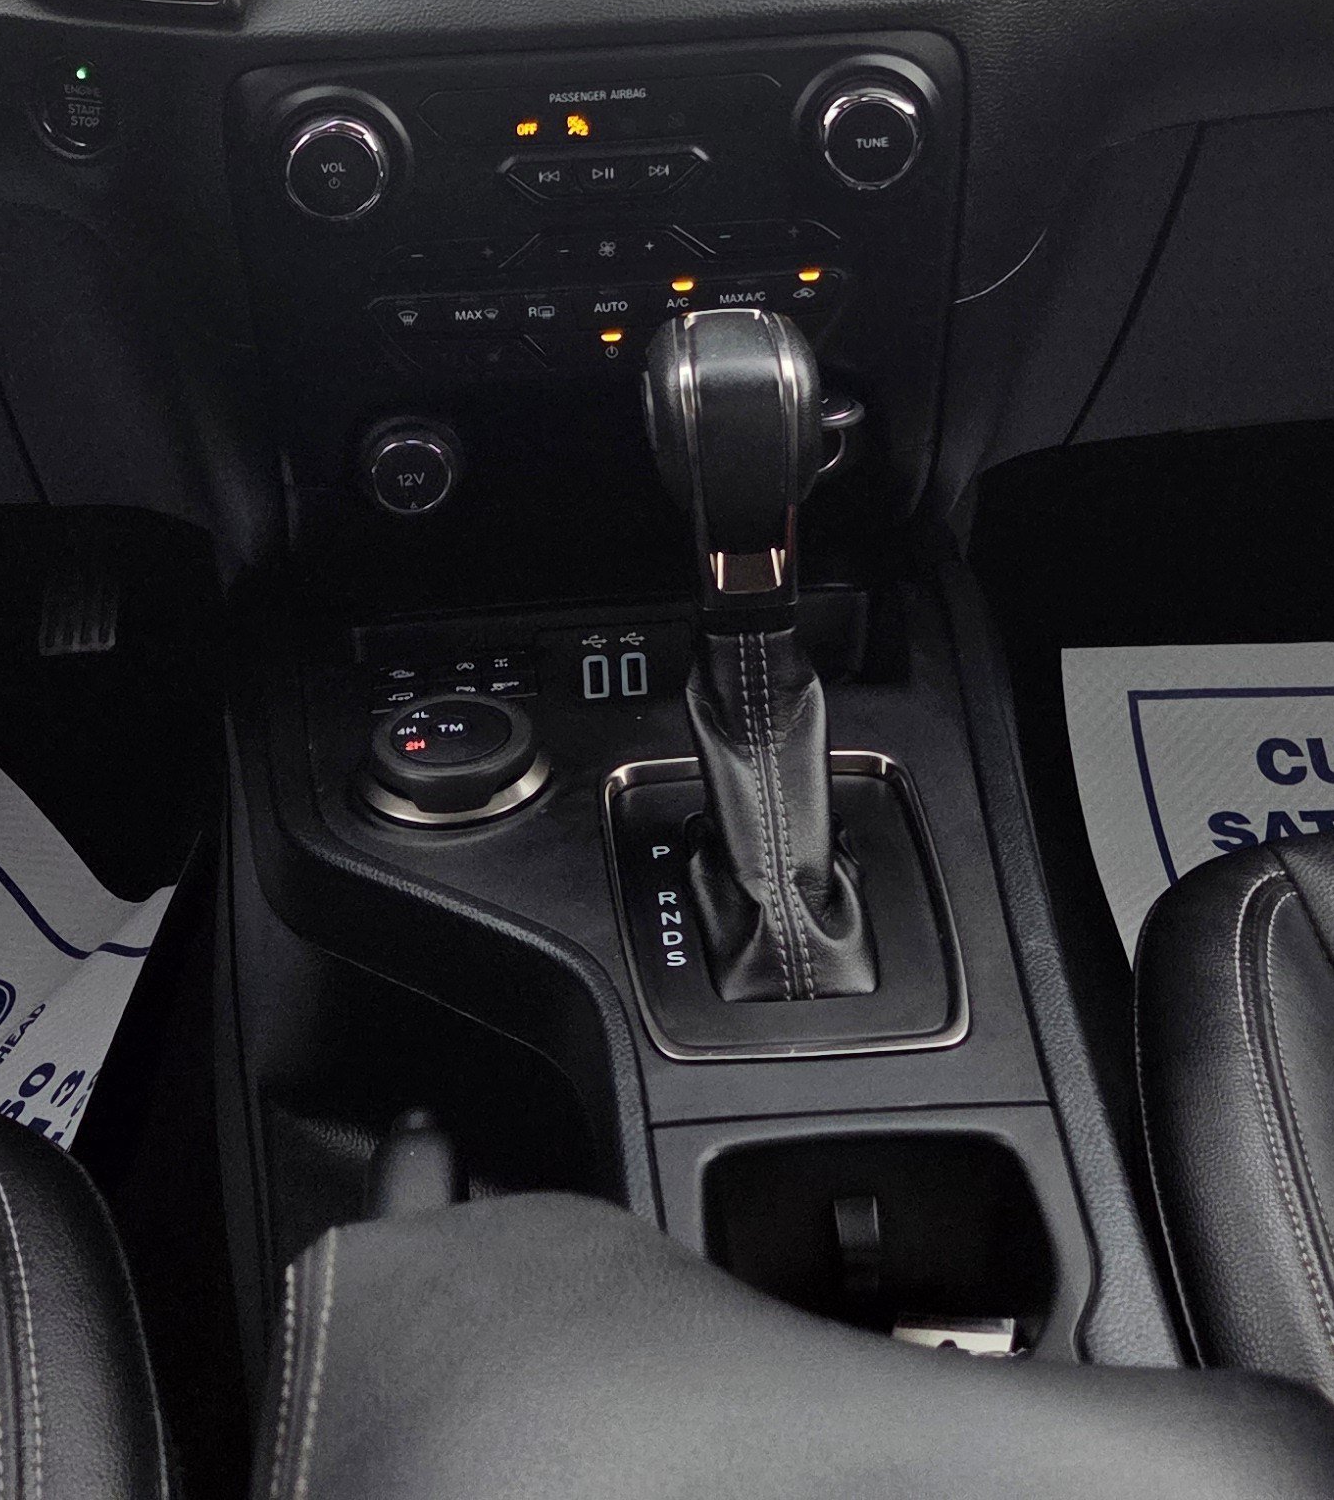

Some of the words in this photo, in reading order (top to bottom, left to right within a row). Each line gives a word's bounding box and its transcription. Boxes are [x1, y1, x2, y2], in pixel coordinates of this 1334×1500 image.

[549, 90, 606, 103] PASSENGER
[610, 88, 646, 99] AIRBAG
[68, 104, 102, 116] START
[71, 116, 100, 128] STOP
[517, 123, 538, 136] OFF
[856, 137, 889, 149] TUNE
[320, 162, 346, 174] VOL
[667, 297, 689, 308] A/C
[719, 293, 744, 304] MAX
[746, 291, 766, 302] A/C
[594, 301, 628, 312] AUTO
[455, 309, 483, 321] MAX
[397, 472, 425, 487] 12V
[411, 711, 430, 719] 4L
[397, 726, 417, 735] 4H
[438, 723, 464, 732] TM
[651, 846, 671, 859] P
[658, 891, 677, 906] R
[661, 910, 682, 926] N
[662, 931, 683, 946] D
[666, 951, 687, 967] S
